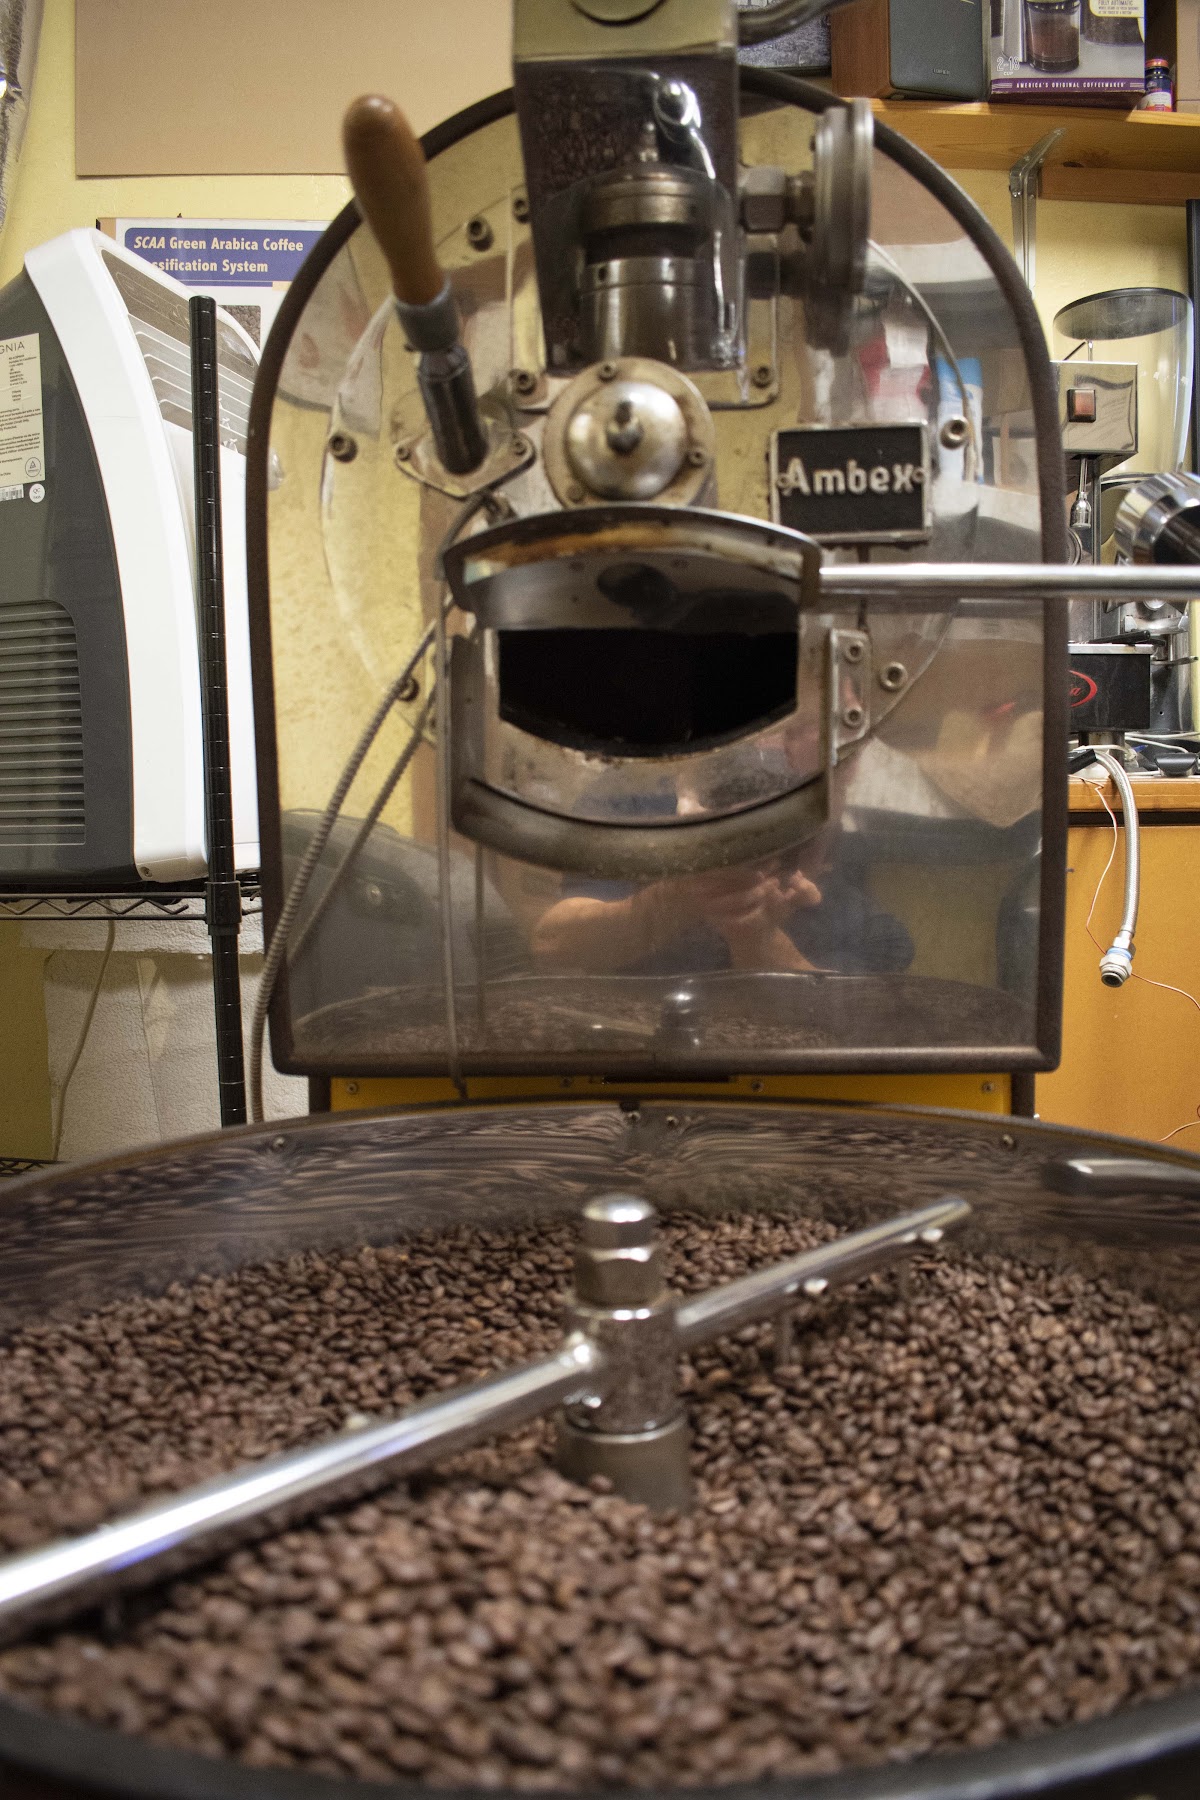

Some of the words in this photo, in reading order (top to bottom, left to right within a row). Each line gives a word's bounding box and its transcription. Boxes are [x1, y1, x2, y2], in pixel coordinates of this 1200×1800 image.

[133, 236, 166, 249] SCAA
[169, 237, 207, 250] Green
[210, 237, 259, 251] Arabica
[262, 238, 304, 251] Coffee
[222, 258, 269, 275] System
[780, 456, 914, 496] Ambex
